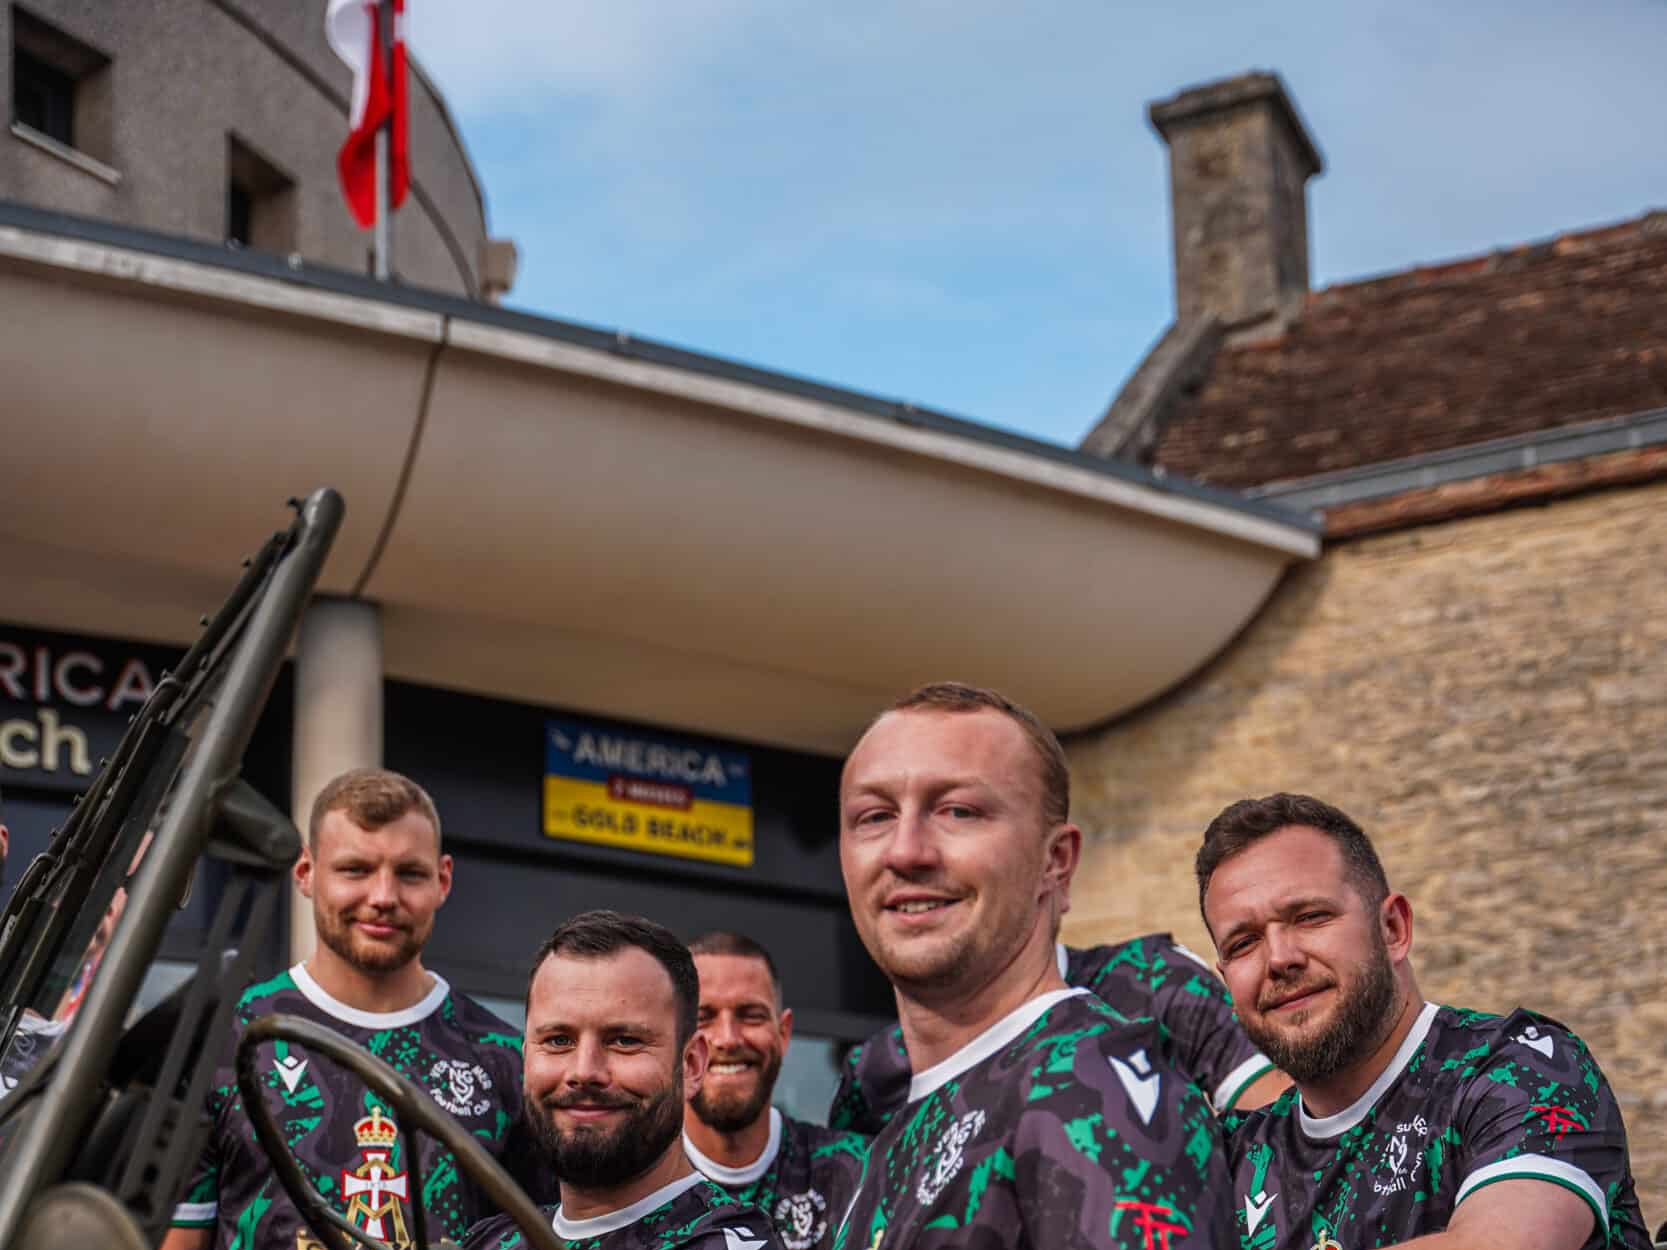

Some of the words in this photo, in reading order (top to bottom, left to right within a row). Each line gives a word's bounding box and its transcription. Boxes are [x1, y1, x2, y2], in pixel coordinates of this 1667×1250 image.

[0, 706, 93, 777] ch
[572, 731, 728, 787] AMERICA
[572, 804, 638, 836] GOLD
